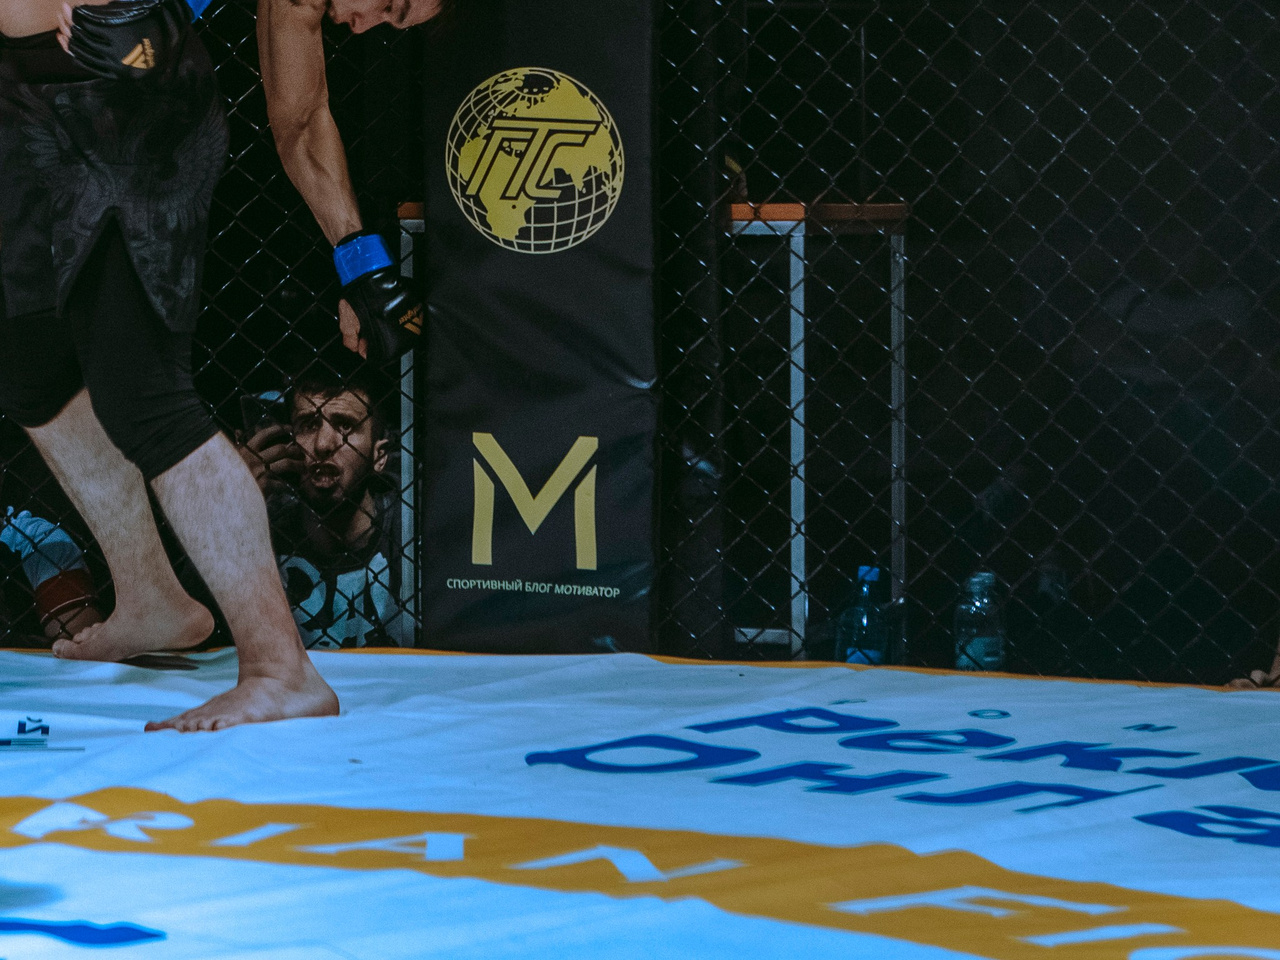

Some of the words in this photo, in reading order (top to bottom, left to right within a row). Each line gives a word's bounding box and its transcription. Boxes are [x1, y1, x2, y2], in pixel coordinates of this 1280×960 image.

[446, 578, 523, 591] СПОРТИВНЫЙ
[524, 581, 553, 594] БЛОГ
[553, 584, 620, 598] МОТИВАТОР
